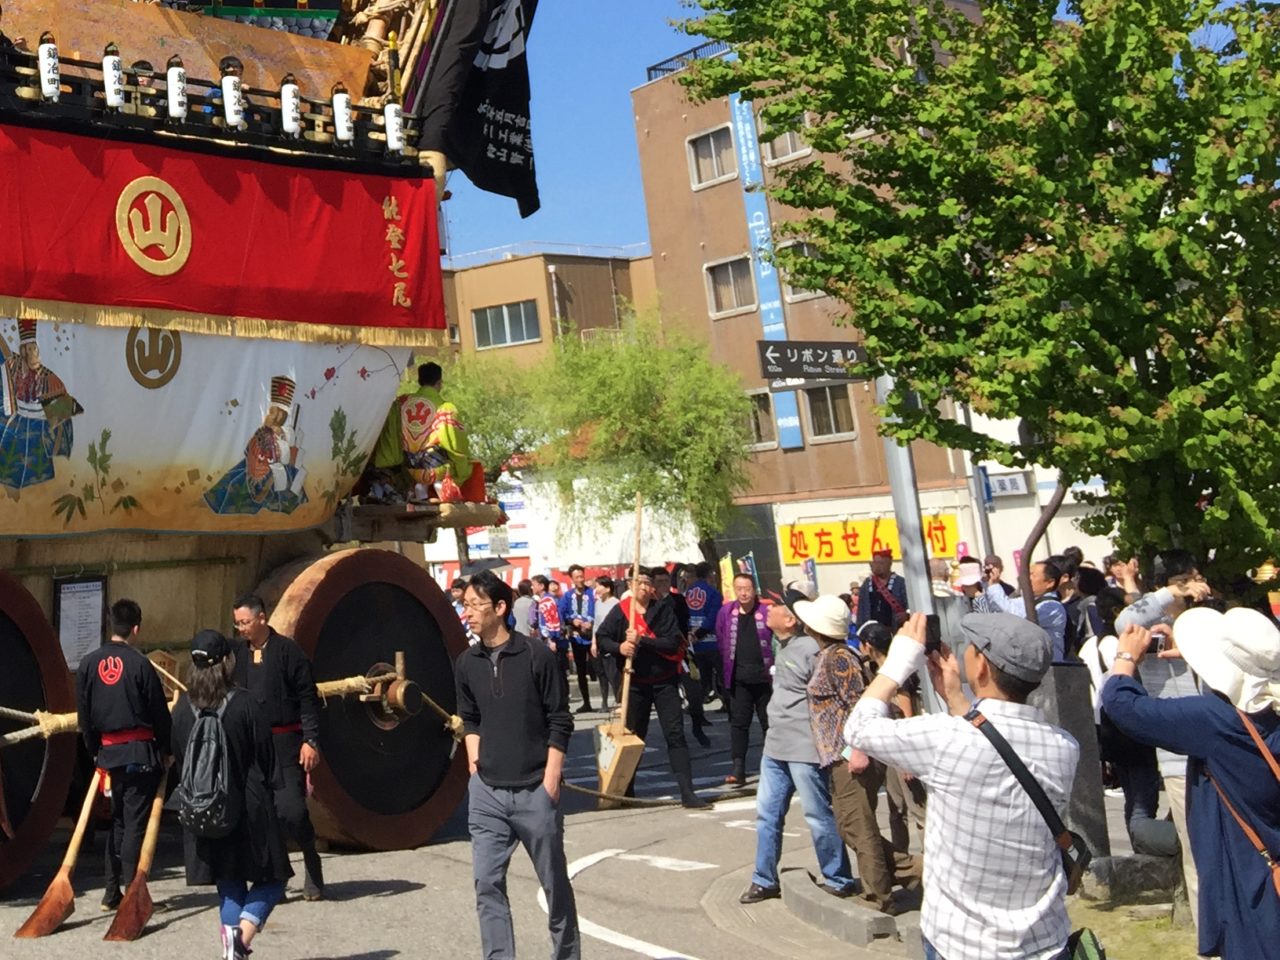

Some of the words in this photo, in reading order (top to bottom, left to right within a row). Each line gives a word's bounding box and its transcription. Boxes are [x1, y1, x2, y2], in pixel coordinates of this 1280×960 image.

[382, 195, 412, 308] 能登七尾
[790, 521, 947, 560] 処方せん付
